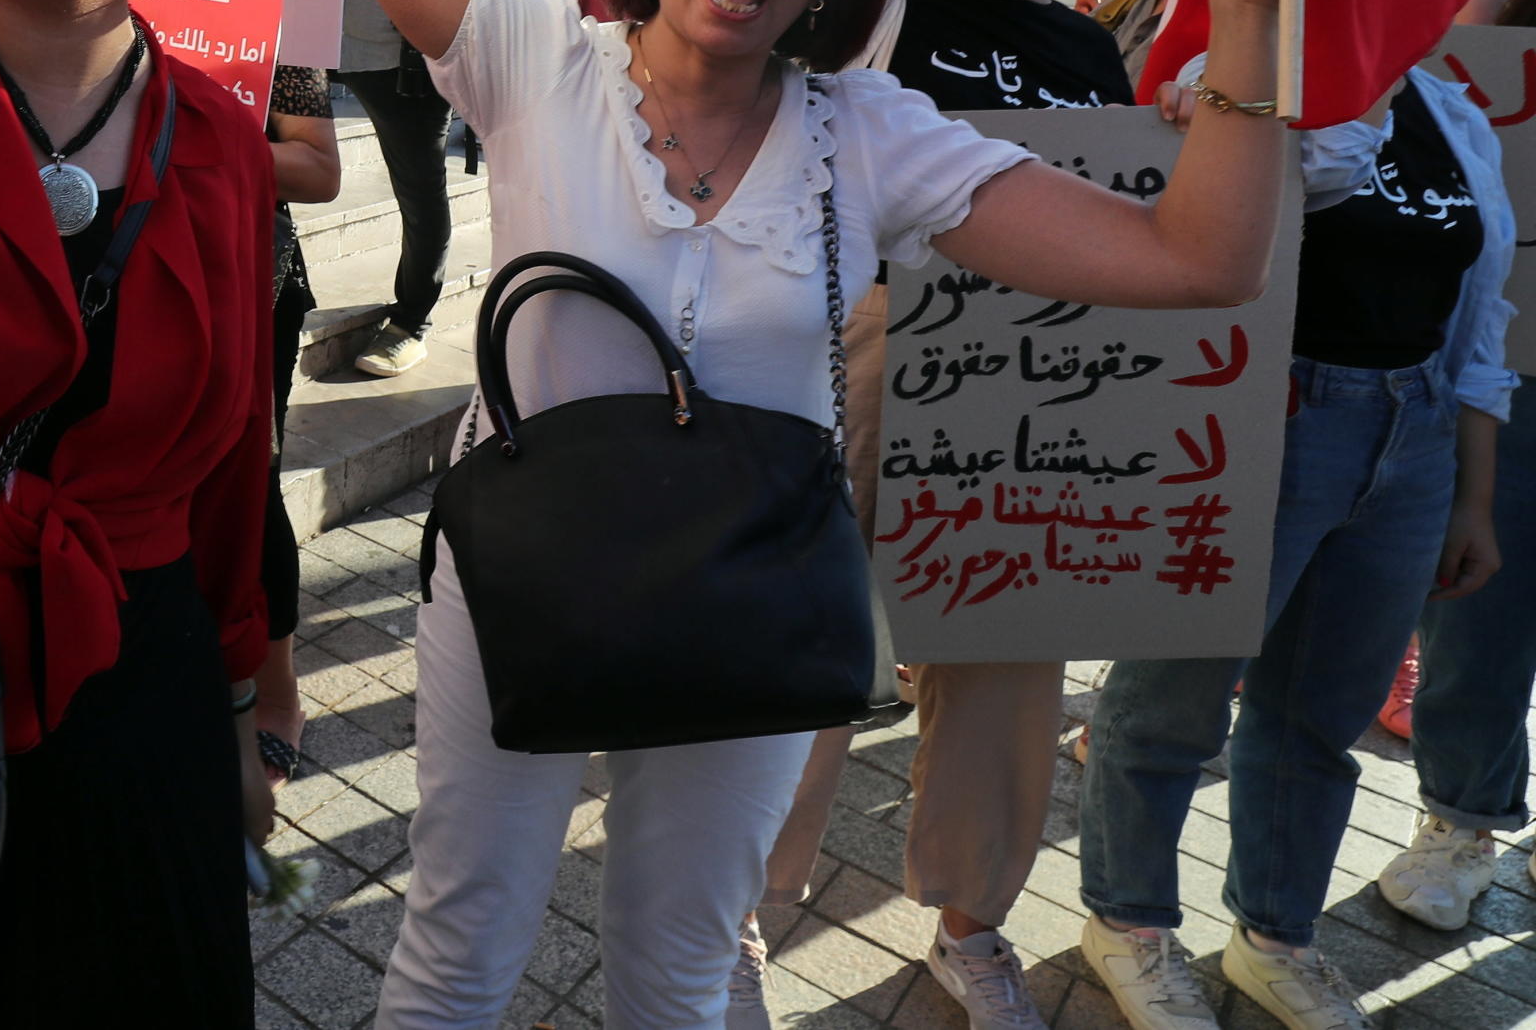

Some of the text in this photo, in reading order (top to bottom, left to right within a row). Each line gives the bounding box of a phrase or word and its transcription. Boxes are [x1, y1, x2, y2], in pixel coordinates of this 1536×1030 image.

[169, 28, 211, 59] بالك
[214, 41, 234, 64] رد
[240, 37, 266, 64] اما
[892, 324, 1249, 407] لا حقوقنا حقوق
[882, 414, 1227, 490] لا عيشتنا عيشة
[875, 480, 983, 543] صفر
